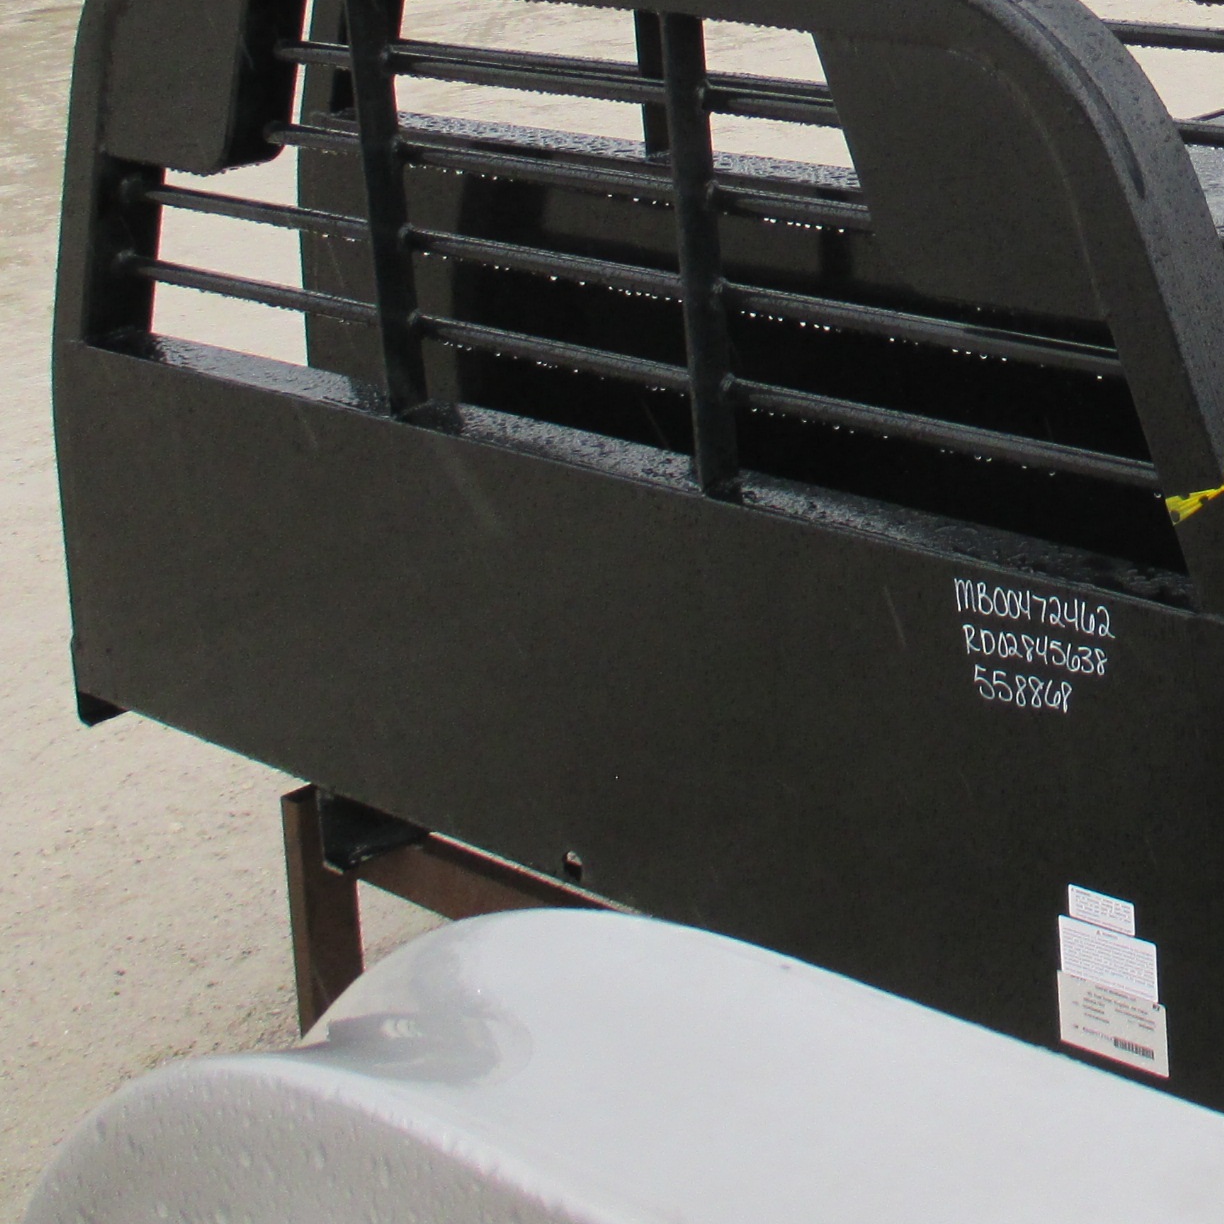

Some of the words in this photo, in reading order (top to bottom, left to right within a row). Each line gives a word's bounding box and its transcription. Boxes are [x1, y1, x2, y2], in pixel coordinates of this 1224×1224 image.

[953, 577, 1117, 639] MB00472462
[962, 623, 1109, 676] RD02845638
[973, 663, 1073, 714] 558868
